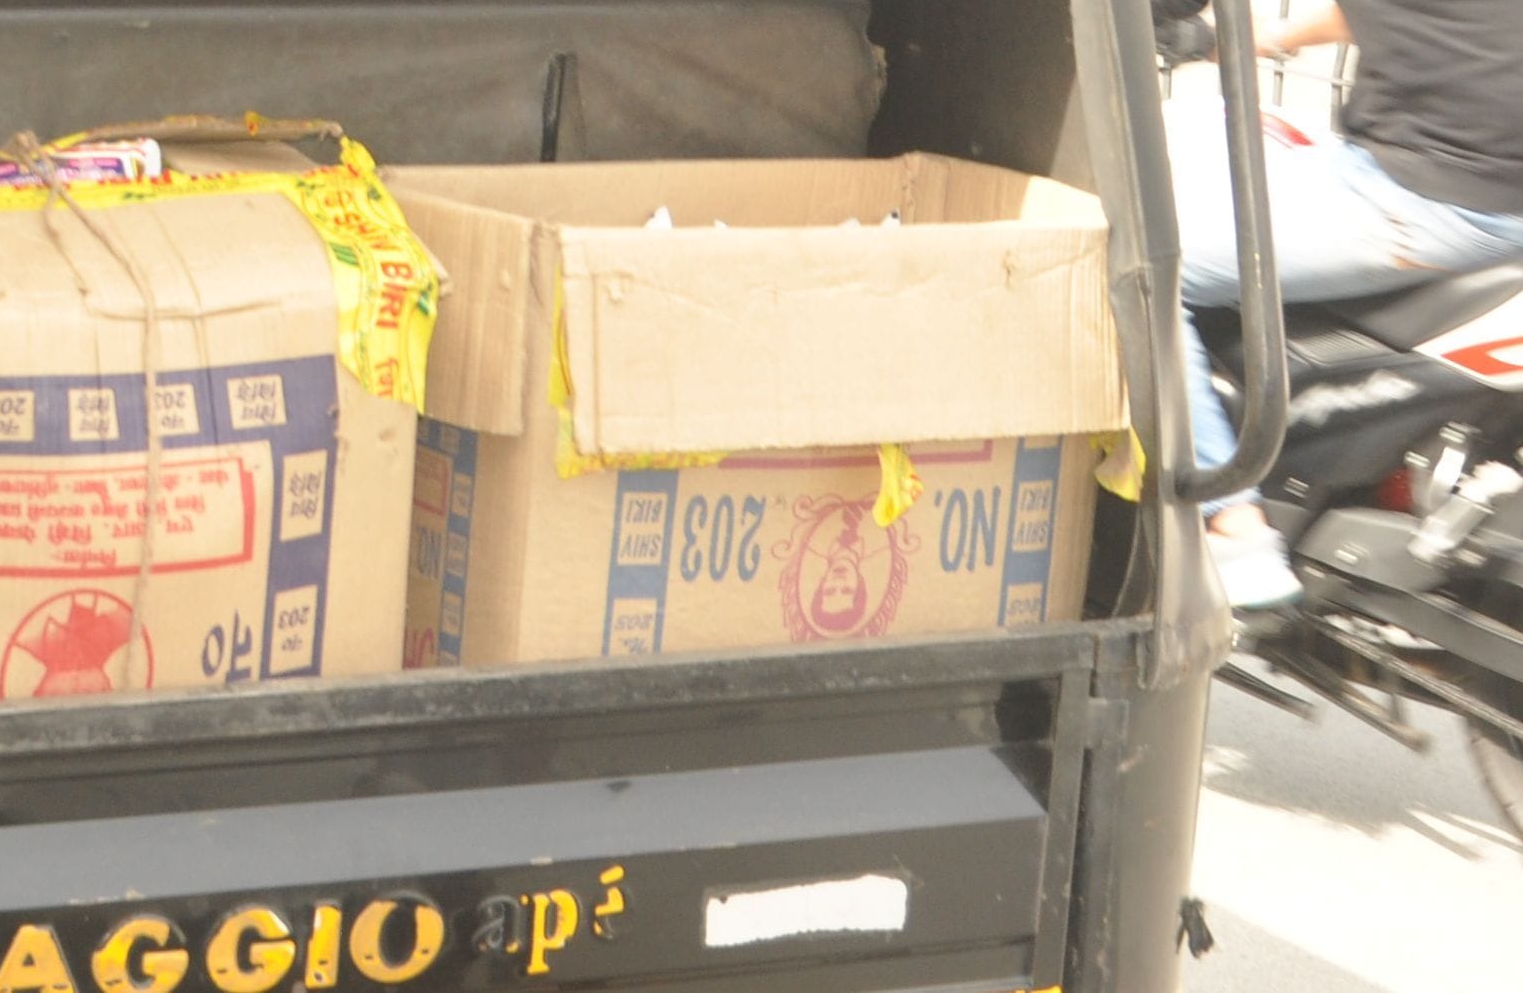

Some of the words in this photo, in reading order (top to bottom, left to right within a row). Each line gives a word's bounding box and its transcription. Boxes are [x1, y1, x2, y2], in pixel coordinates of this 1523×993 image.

[375, 262, 414, 330] BIRI
[680, 494, 768, 583] 203
[934, 485, 1003, 573] NO.
